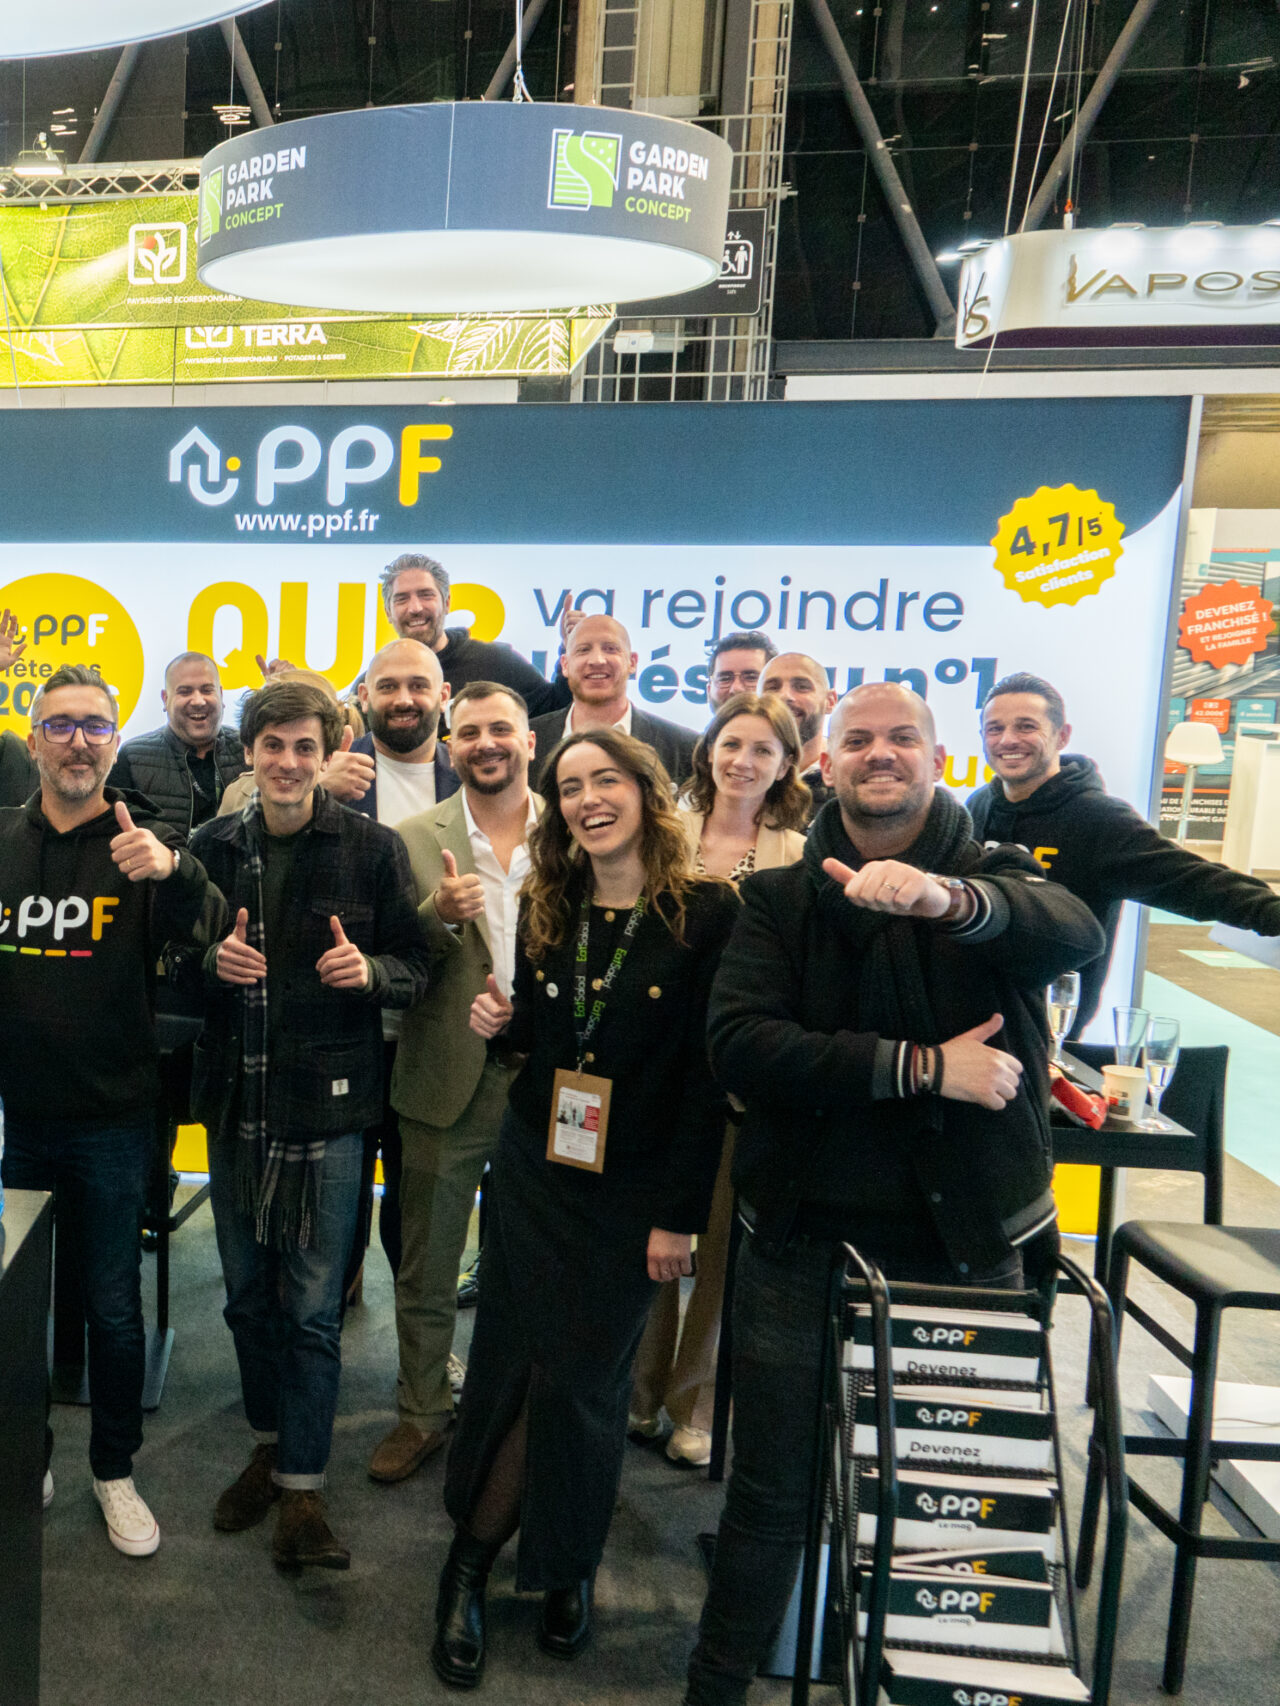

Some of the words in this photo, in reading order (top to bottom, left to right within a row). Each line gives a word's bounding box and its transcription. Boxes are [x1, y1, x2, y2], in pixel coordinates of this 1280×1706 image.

[227, 146, 306, 185] GARDEN
[629, 140, 709, 181] GARDEN
[226, 178, 275, 210] PARK
[626, 167, 686, 201] PARK
[225, 203, 284, 231] CONCEPT
[625, 196, 692, 224] CONCEPT
[239, 324, 328, 347] TERRA
[256, 423, 454, 507] PPF
[235, 509, 380, 538] www.ppf.fr
[1014, 547, 1111, 583] Satisfaction
[1040, 569, 1095, 593] clients
[533, 587, 613, 628] va
[641, 575, 965, 647] rejoindre
[1187, 611, 1260, 636] FRANCHISÉ
[1262, 611, 1268, 622] !
[1195, 600, 1256, 621] DEVENEZ
[33, 613, 109, 647] PPF
[1200, 636, 1210, 644] ET
[1211, 627, 1258, 642] REJOIGNEZ
[1205, 643, 1217, 651] LA
[17, 895, 120, 941] PPF
[932, 1327, 978, 1346] PPF
[907, 1360, 978, 1377] Devenez
[936, 1408, 982, 1427] PPF
[910, 1441, 981, 1457] Devenez
[940, 1494, 997, 1519] PPF
[940, 1589, 996, 1614] PPF
